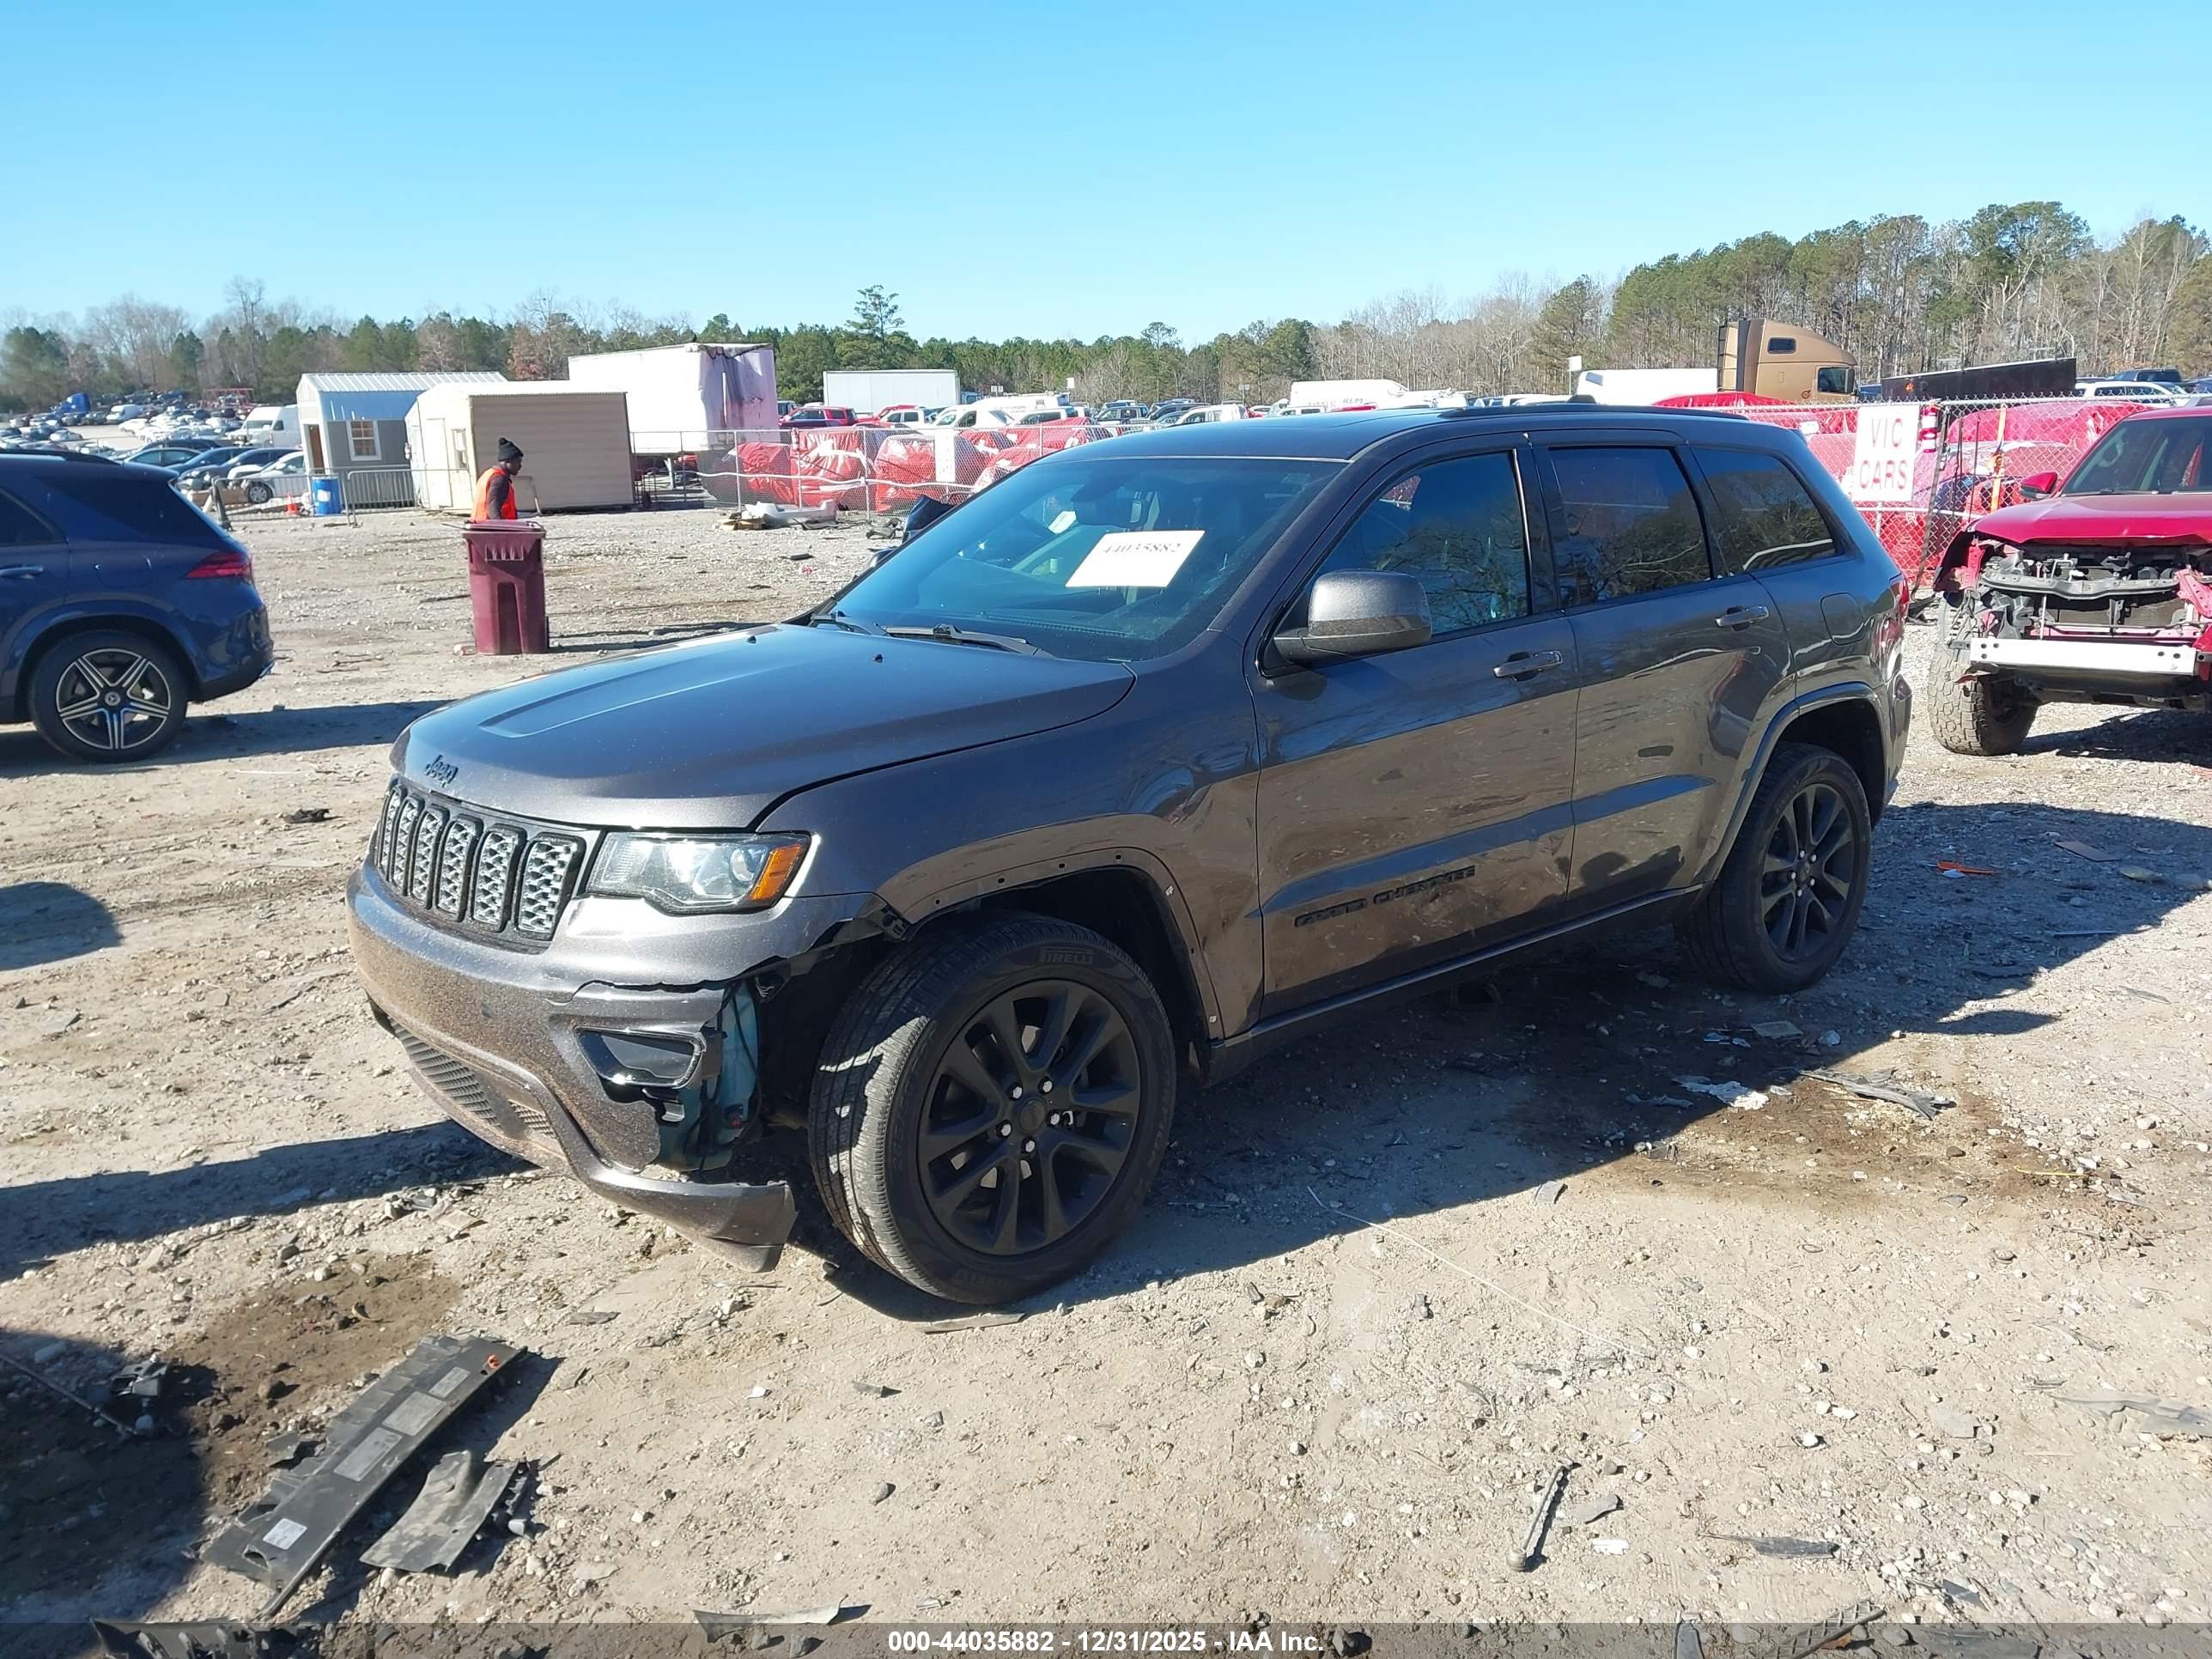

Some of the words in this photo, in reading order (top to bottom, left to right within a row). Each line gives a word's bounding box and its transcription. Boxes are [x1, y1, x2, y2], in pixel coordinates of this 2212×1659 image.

[1870, 417, 1904, 448] VIC
[1858, 459, 1908, 489] CARS
[424, 754, 459, 788] Jeep
[1373, 865, 1476, 905] CHEROKEE
[1039, 946, 1094, 965] PIRELLI
